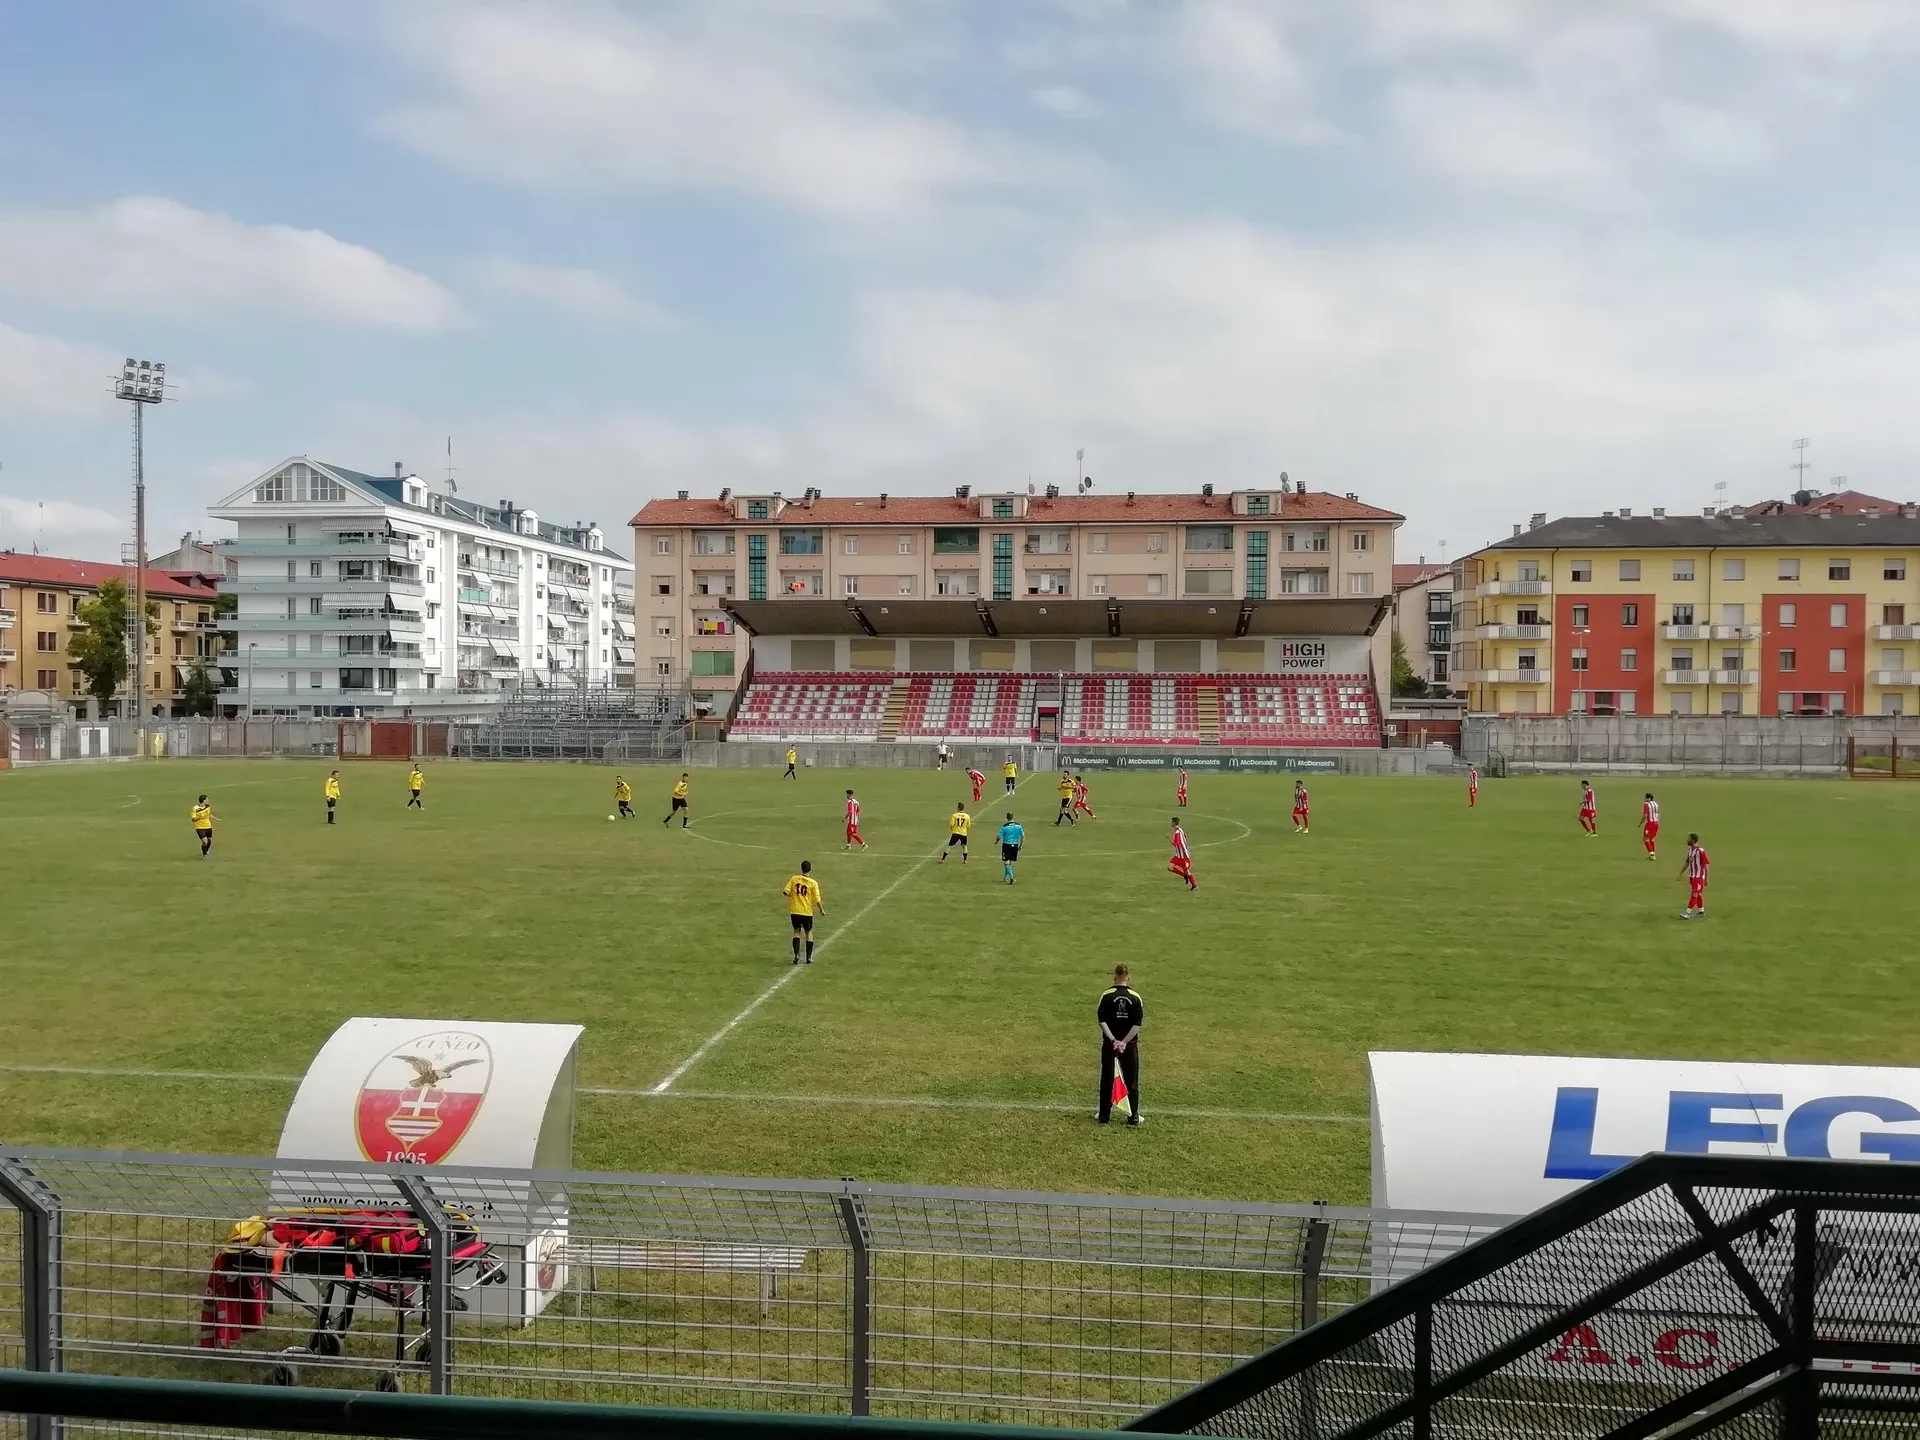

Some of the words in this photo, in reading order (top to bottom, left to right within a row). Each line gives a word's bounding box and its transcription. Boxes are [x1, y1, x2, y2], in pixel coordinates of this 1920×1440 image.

[1283, 643, 1325, 656] HIGH
[956, 817, 966, 827] 17
[795, 882, 808, 897] 10
